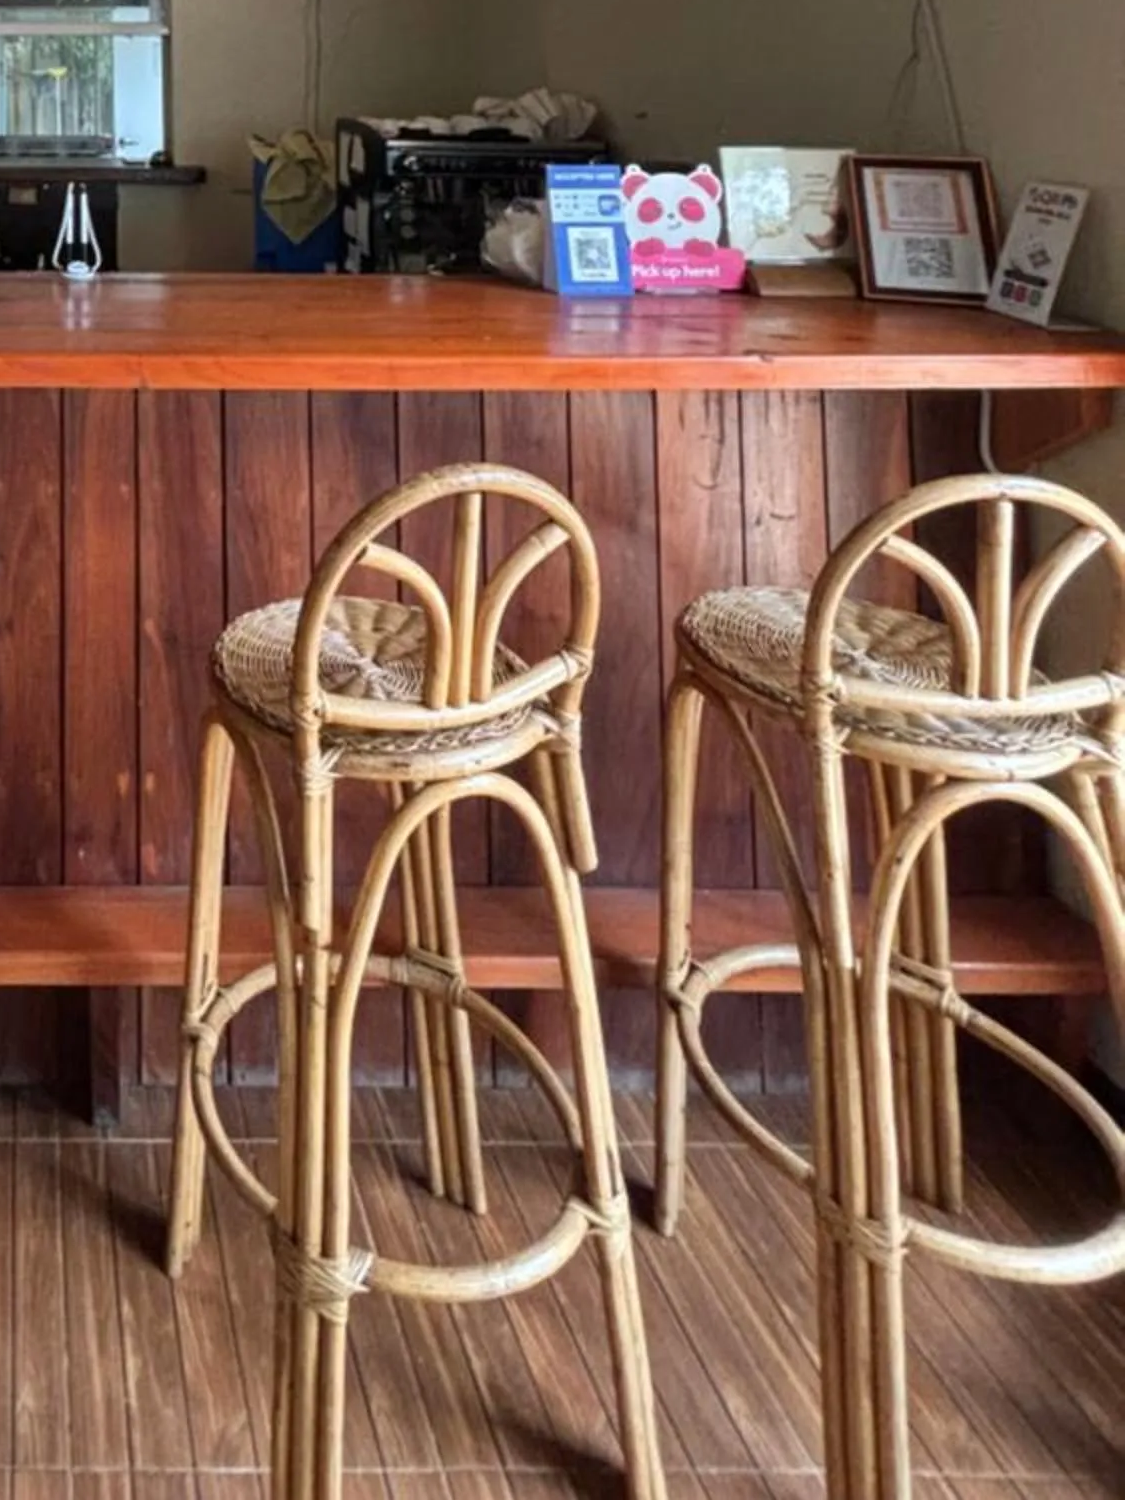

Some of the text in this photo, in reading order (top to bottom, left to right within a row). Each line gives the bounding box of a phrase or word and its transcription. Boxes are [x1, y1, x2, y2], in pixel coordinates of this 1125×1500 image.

[632, 264, 720, 283] Pick up here!
